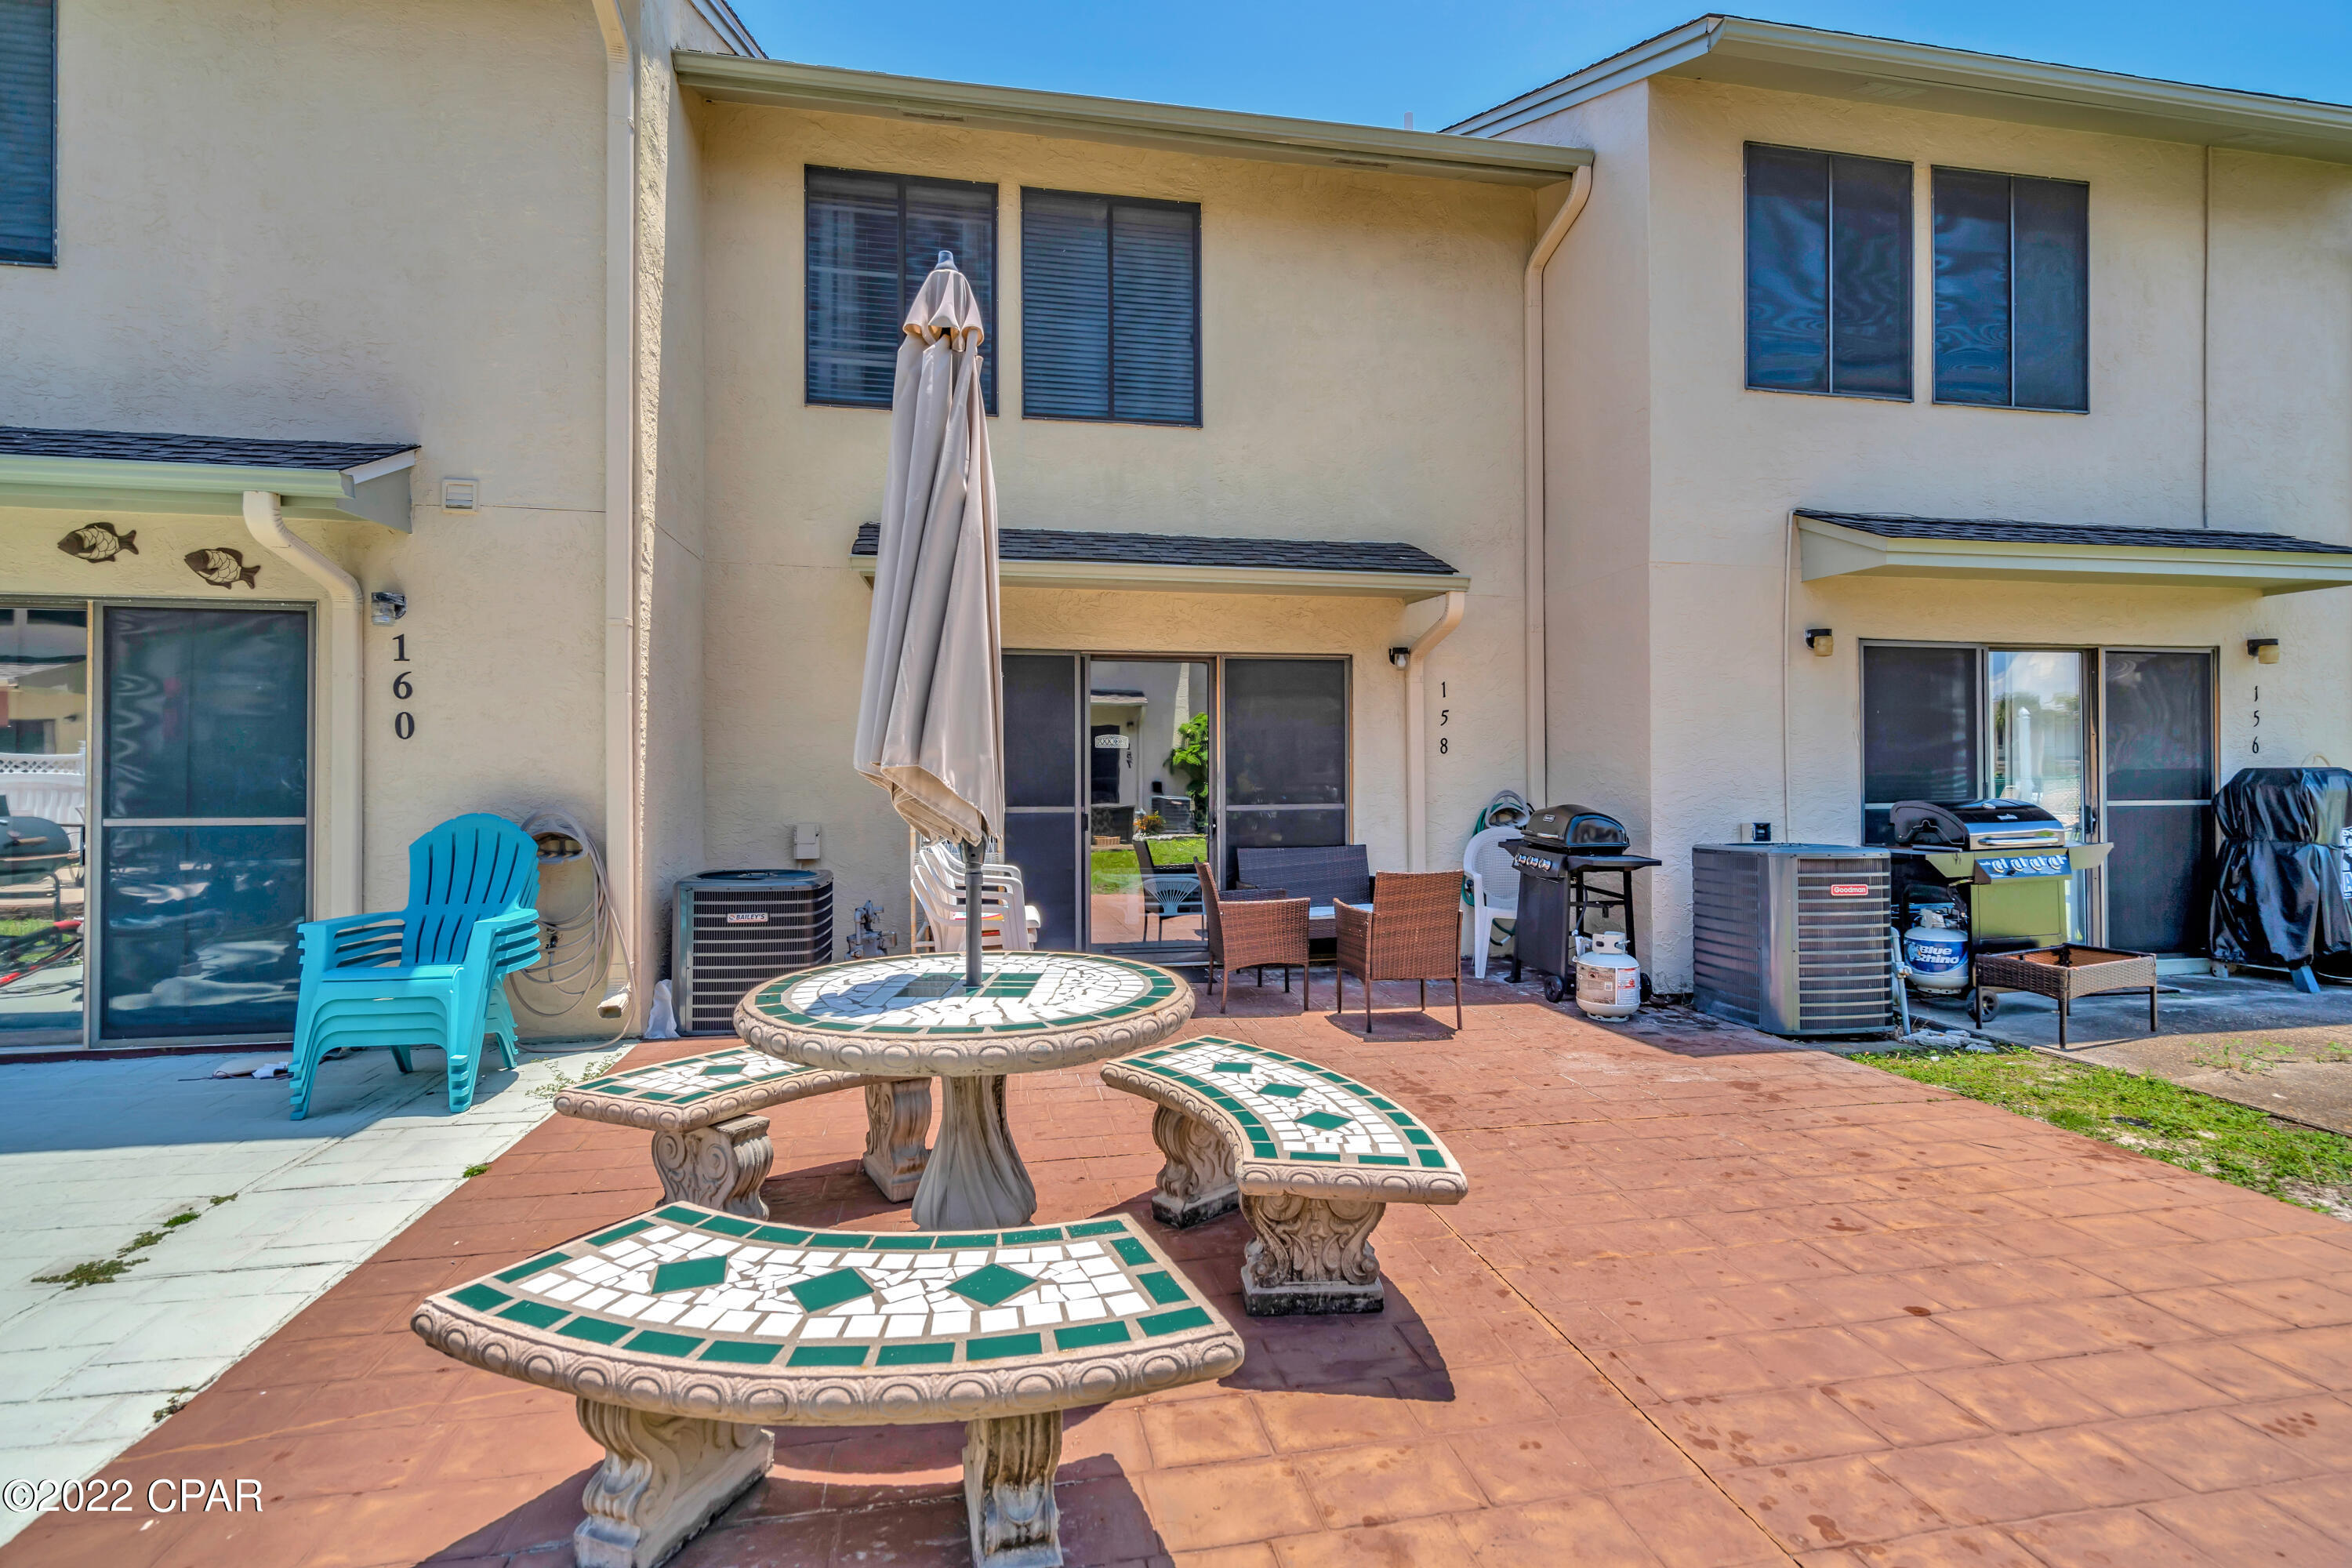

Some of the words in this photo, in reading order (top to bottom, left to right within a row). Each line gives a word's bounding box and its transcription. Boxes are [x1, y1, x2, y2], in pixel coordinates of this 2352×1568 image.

[392, 633, 415, 739] 160
[1440, 681, 1449, 753] 158
[1919, 946, 1952, 955] Blue
